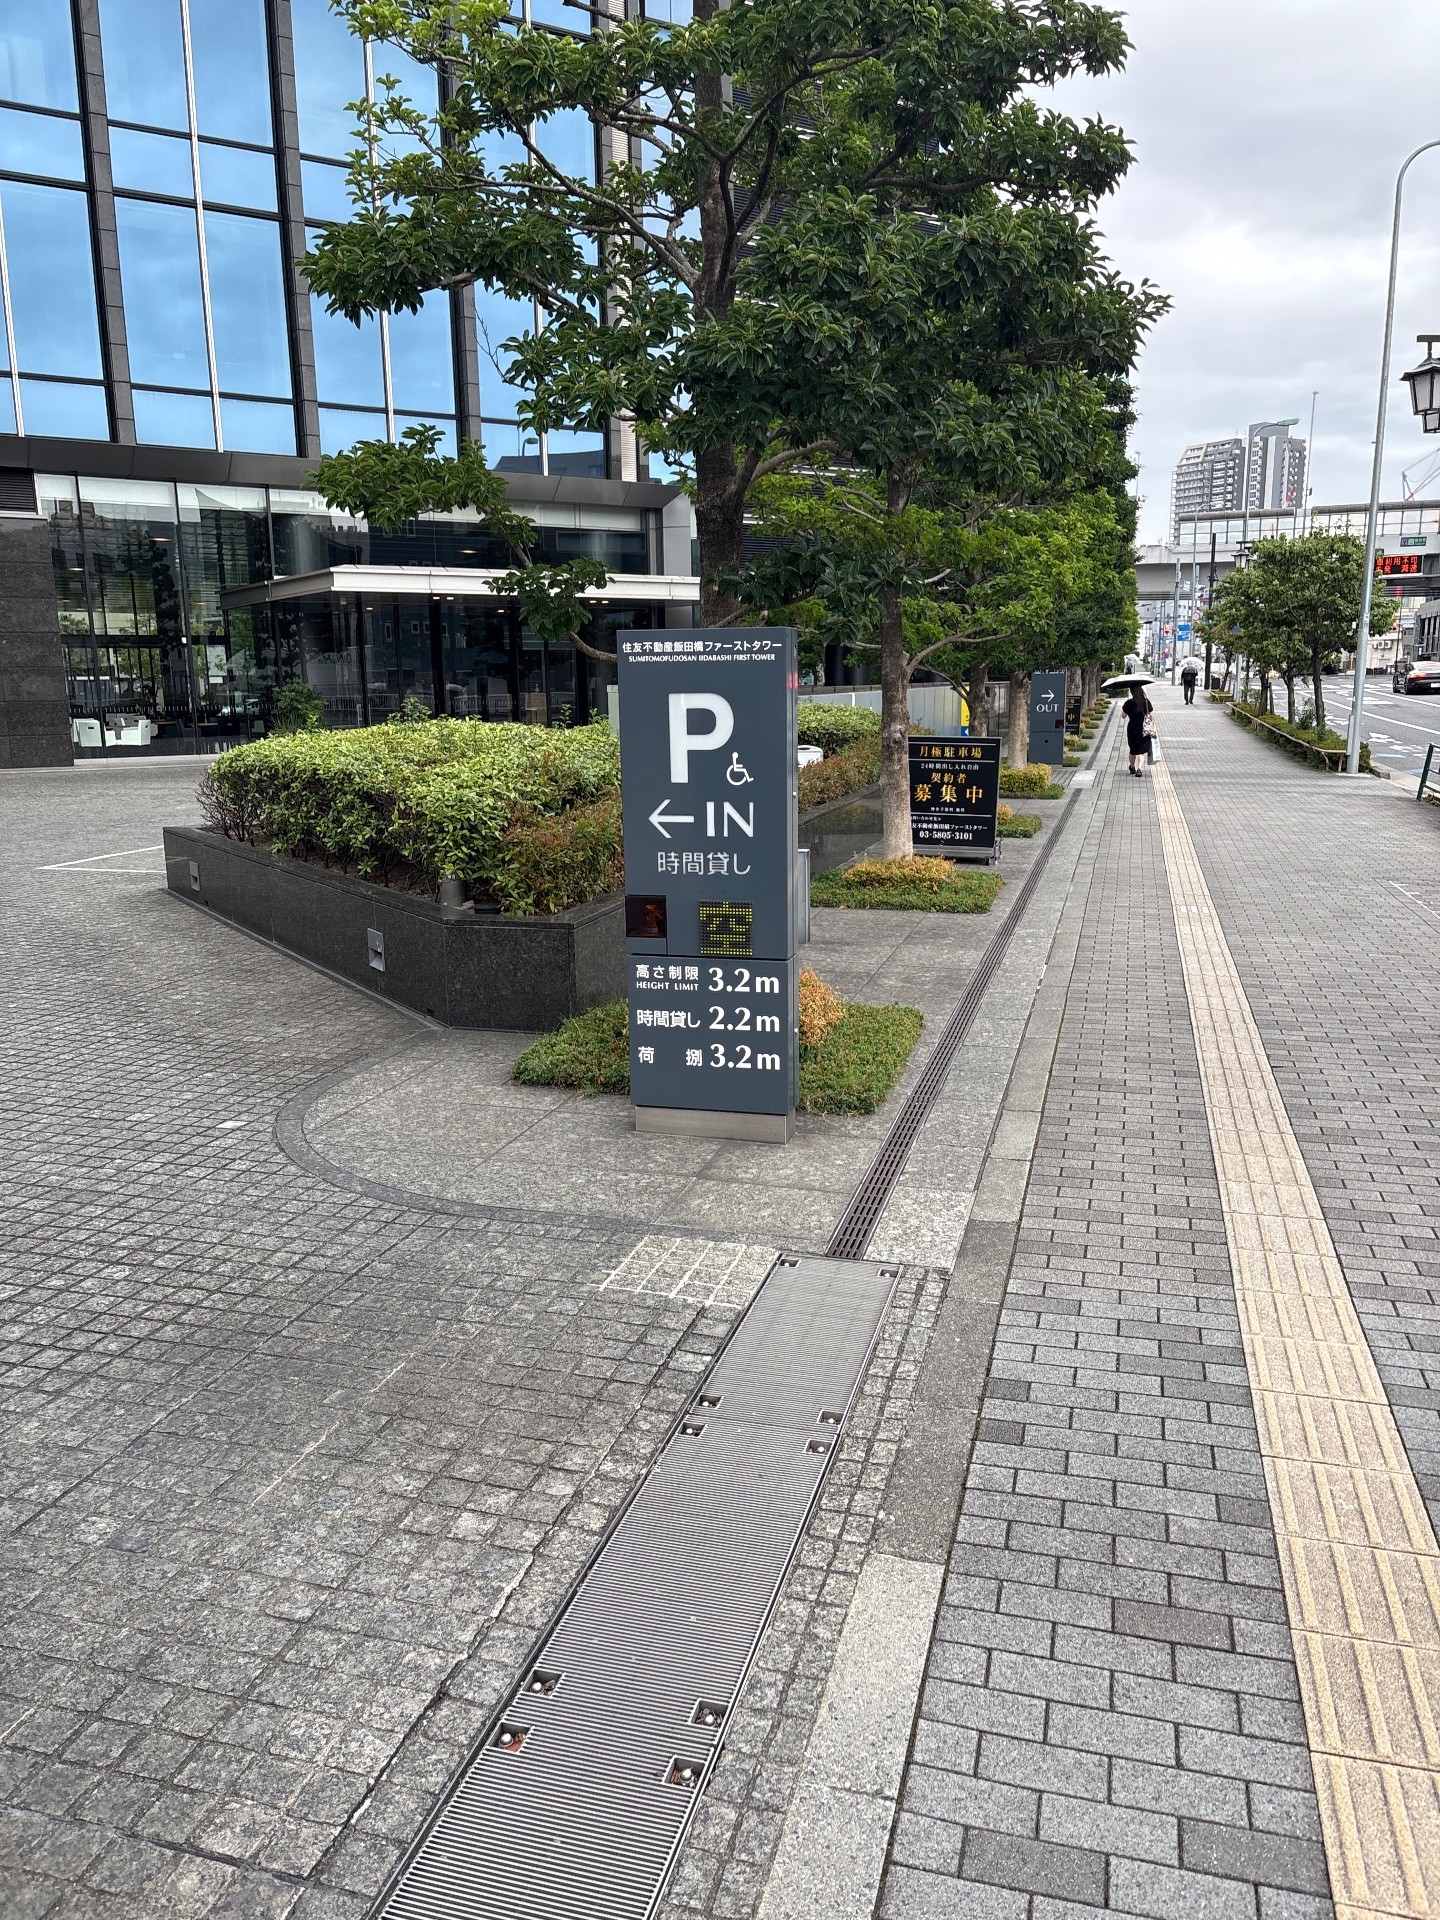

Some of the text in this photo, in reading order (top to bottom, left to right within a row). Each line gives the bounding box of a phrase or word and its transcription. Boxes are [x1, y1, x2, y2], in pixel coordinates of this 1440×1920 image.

[622, 641, 783, 653] 住友不動産飯田橋ファーストタワー
[628, 654, 698, 663] SUMITOMOFUDOSAN
[698, 654, 732, 662] IIDABASHI
[751, 653, 776, 661] TOWER
[1036, 703, 1060, 713] OUT
[668, 692, 735, 784] P
[919, 746, 983, 759] 月極駐車場
[930, 772, 967, 784] 契約者
[914, 784, 983, 804] 募集中
[706, 801, 754, 838] IN
[911, 822, 988, 831] 友不動産飯田橋ファーストタワー
[919, 830, 973, 840] 03-5805-3101
[657, 851, 751, 876] 時間貸し
[700, 901, 753, 956] 空
[635, 964, 780, 994] 高さ制限 3.2m
[636, 981, 699, 991] HEIGHT LIMIT
[636, 1006, 780, 1032] 時間貸し 2.2m
[709, 1043, 781, 1071] 3.2m
